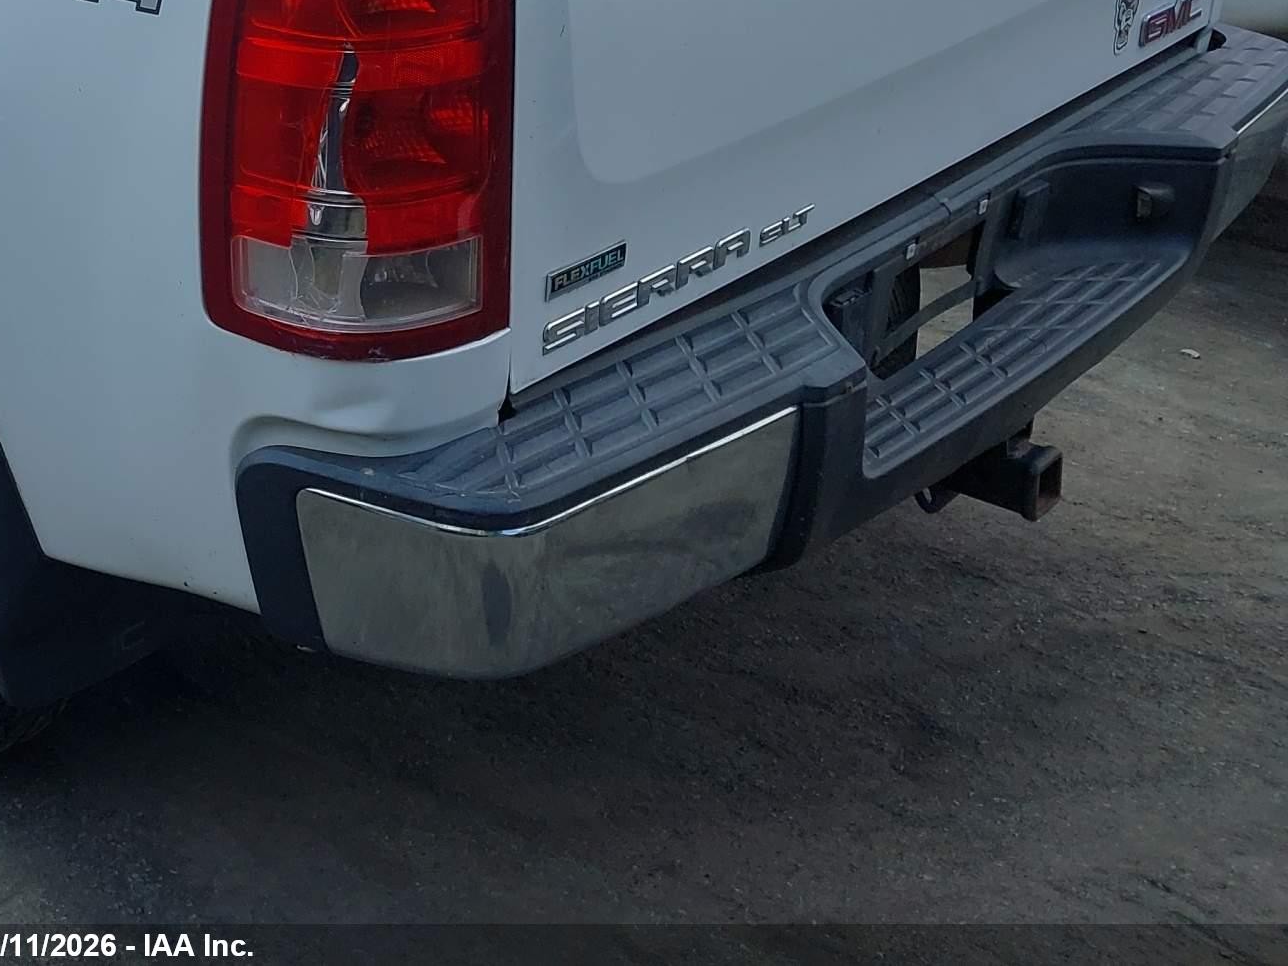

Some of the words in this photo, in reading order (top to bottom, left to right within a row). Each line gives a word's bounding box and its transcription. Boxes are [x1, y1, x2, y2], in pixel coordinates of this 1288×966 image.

[542, 227, 752, 356] SIERRA
[758, 203, 816, 248] SLT
[553, 248, 625, 292] FLEXFUEL
